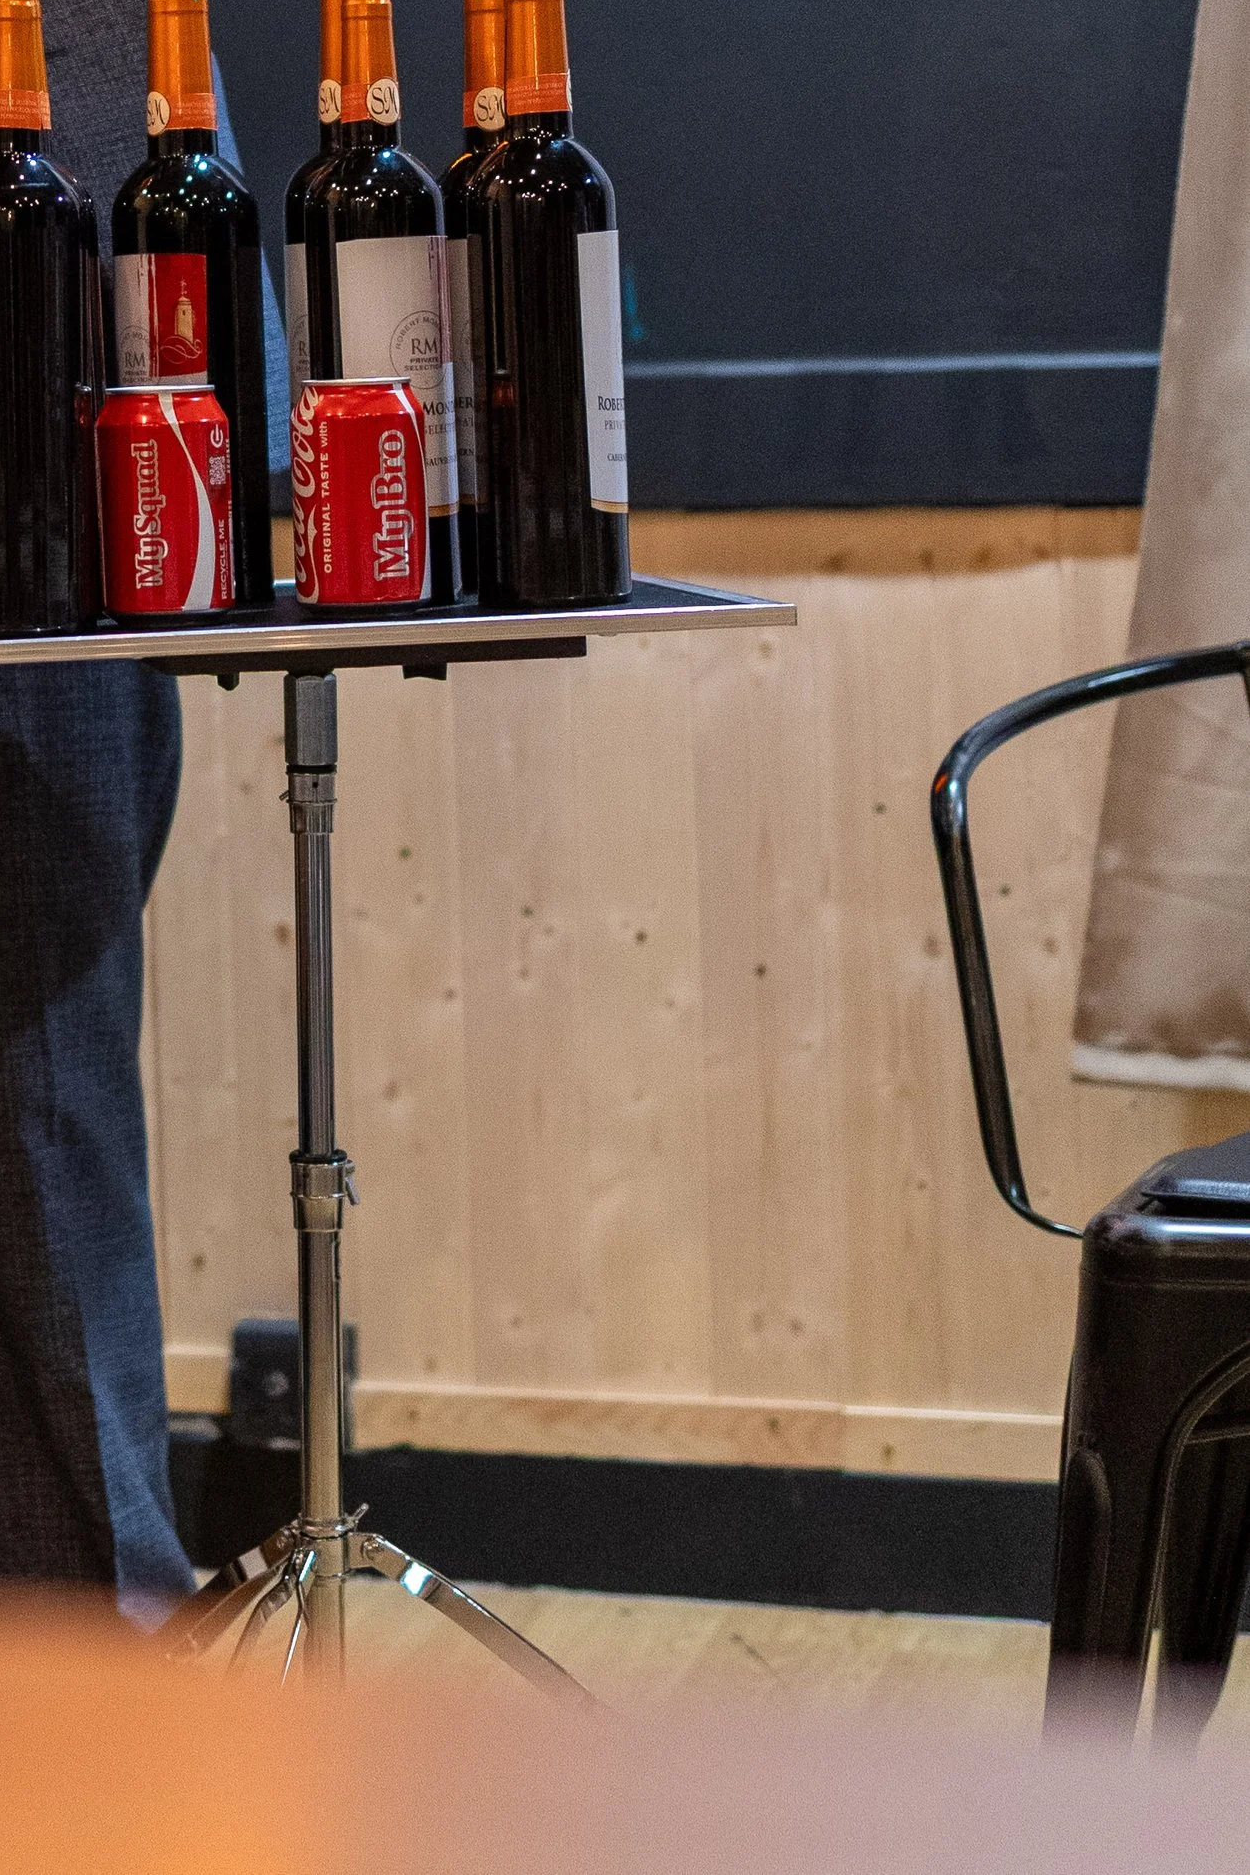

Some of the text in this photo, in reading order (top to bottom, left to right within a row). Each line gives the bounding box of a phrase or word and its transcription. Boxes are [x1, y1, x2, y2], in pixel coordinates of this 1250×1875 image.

[411, 337, 438, 356] RM
[319, 421, 333, 574] ORIGINAL TASTE with
[218, 519, 228, 600] RECYCLE ME
